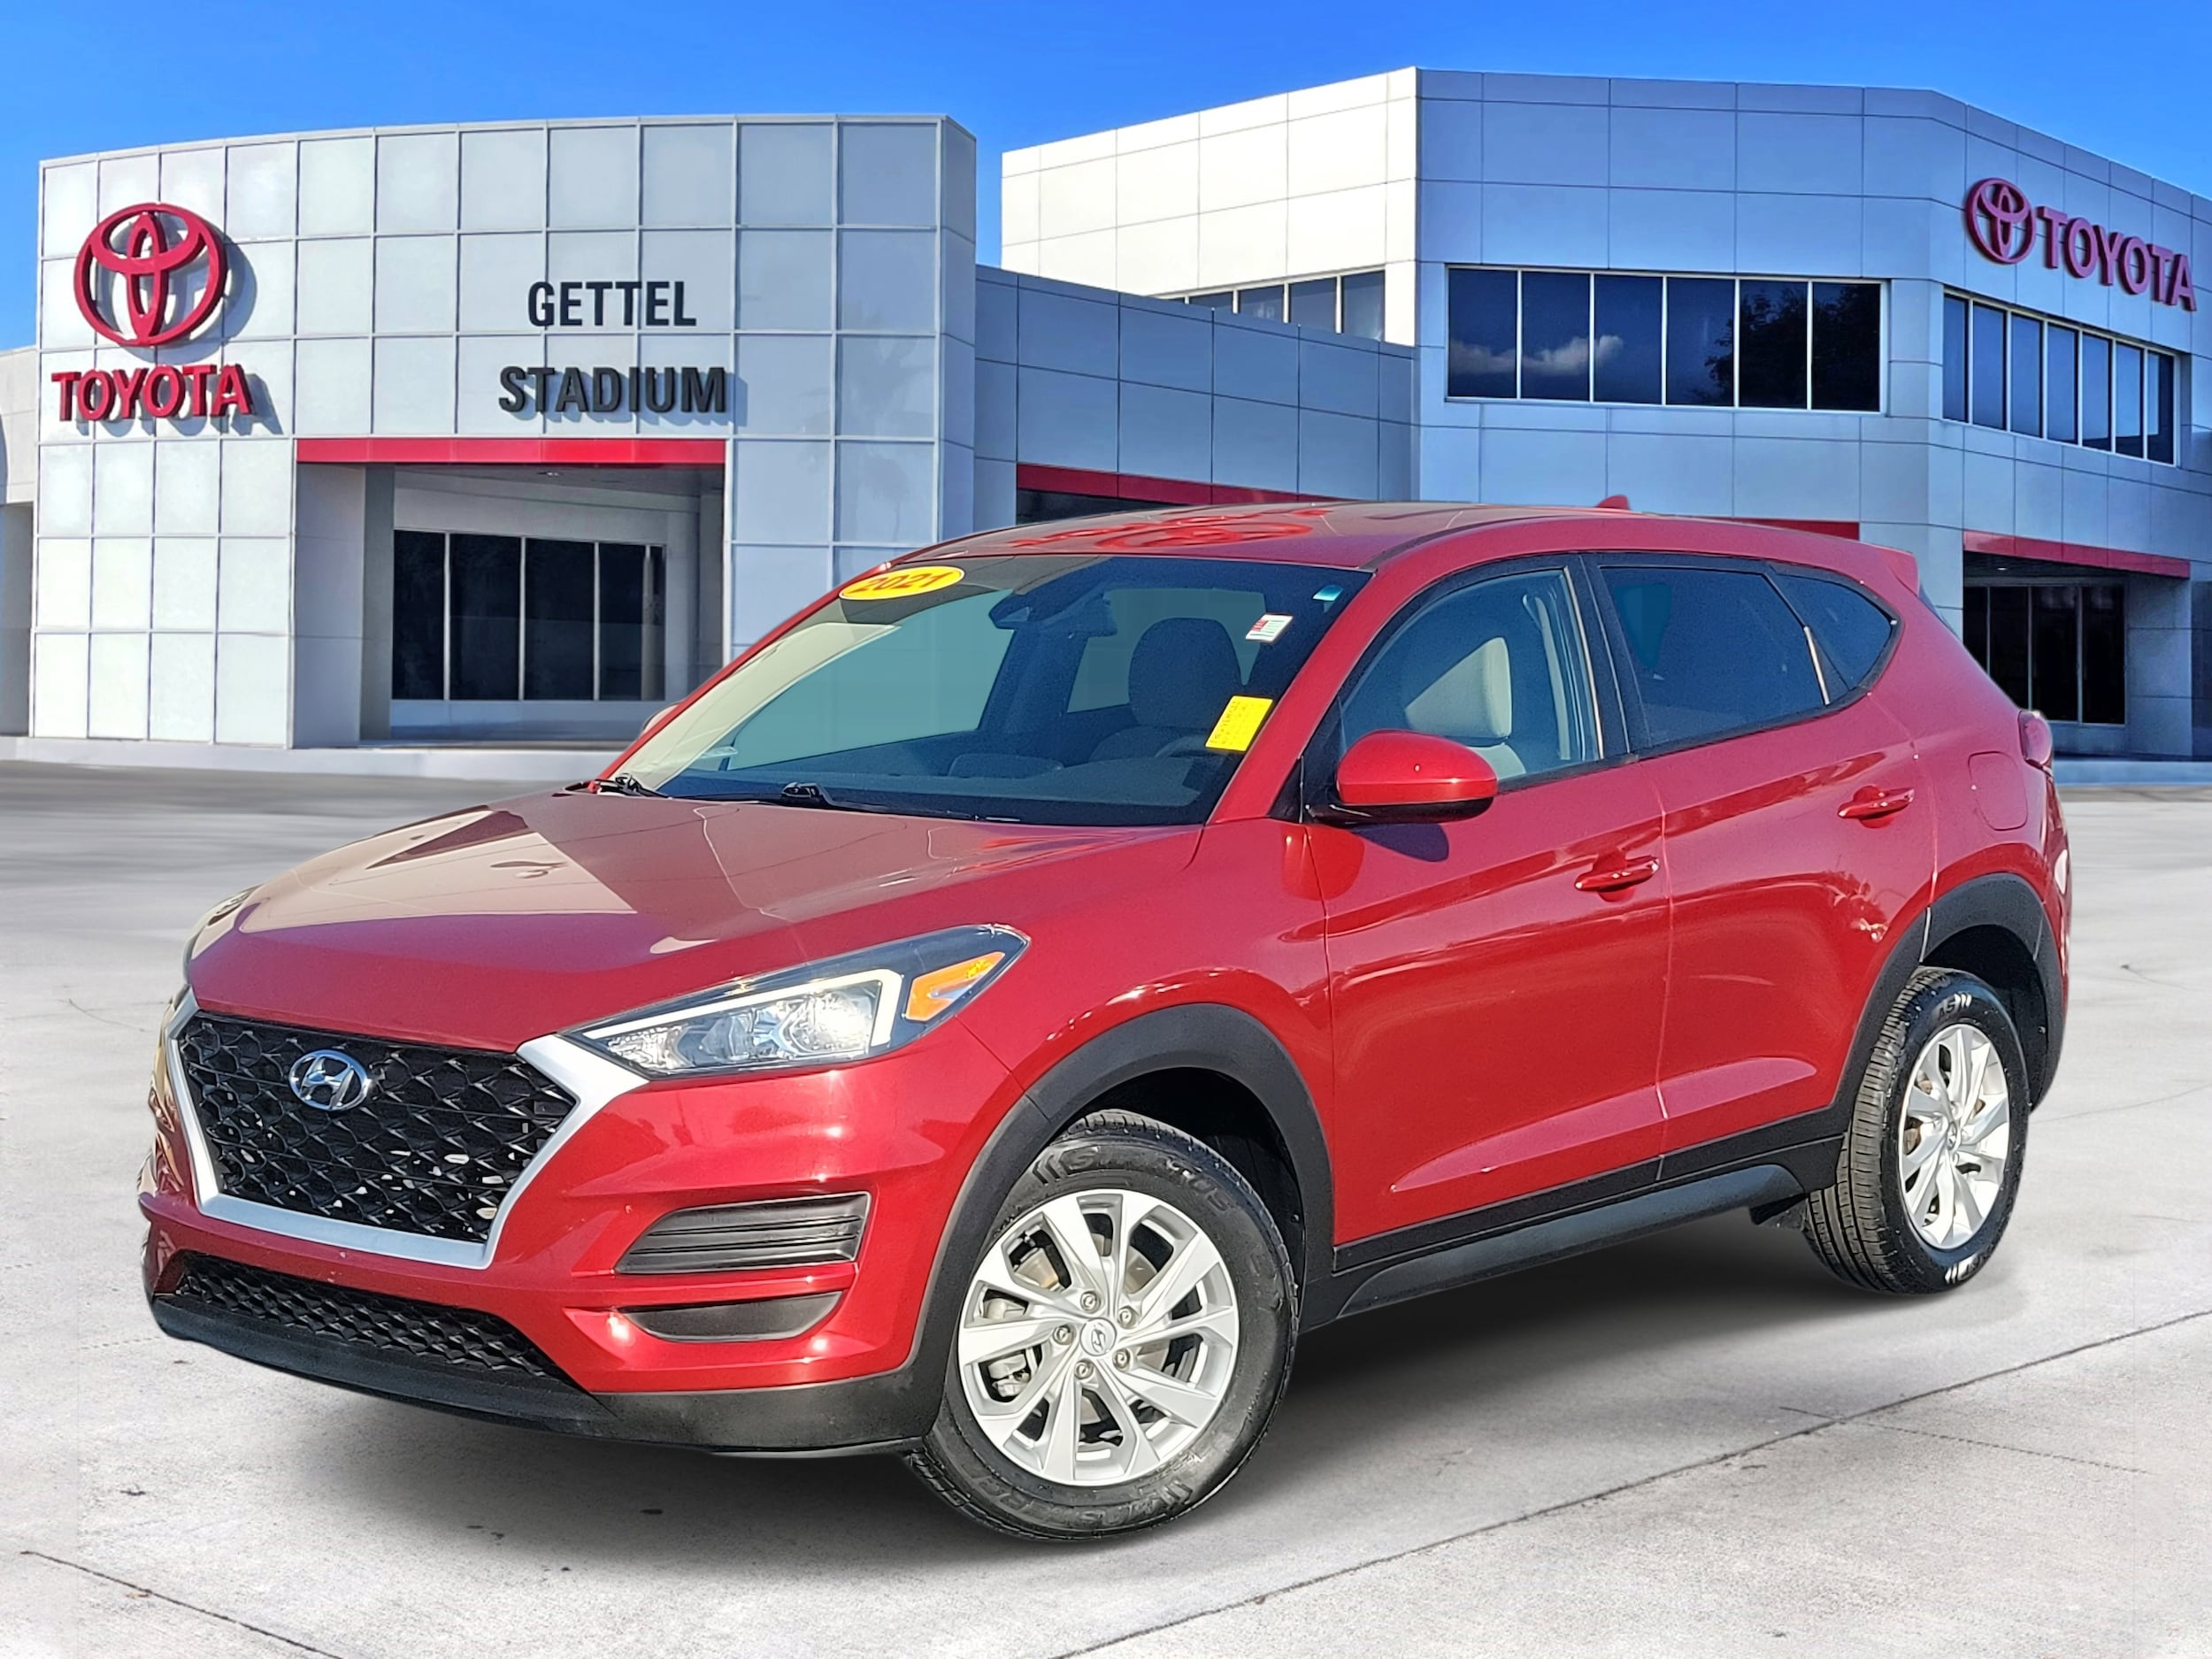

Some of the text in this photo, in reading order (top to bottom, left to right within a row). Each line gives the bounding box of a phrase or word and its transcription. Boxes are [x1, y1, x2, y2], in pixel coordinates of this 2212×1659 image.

[2037, 205, 2197, 311] TOYOTA
[527, 280, 697, 326] GETTEL
[51, 364, 254, 421] TOYOTA
[498, 366, 726, 413] STADIUM
[847, 571, 954, 594] 2021
